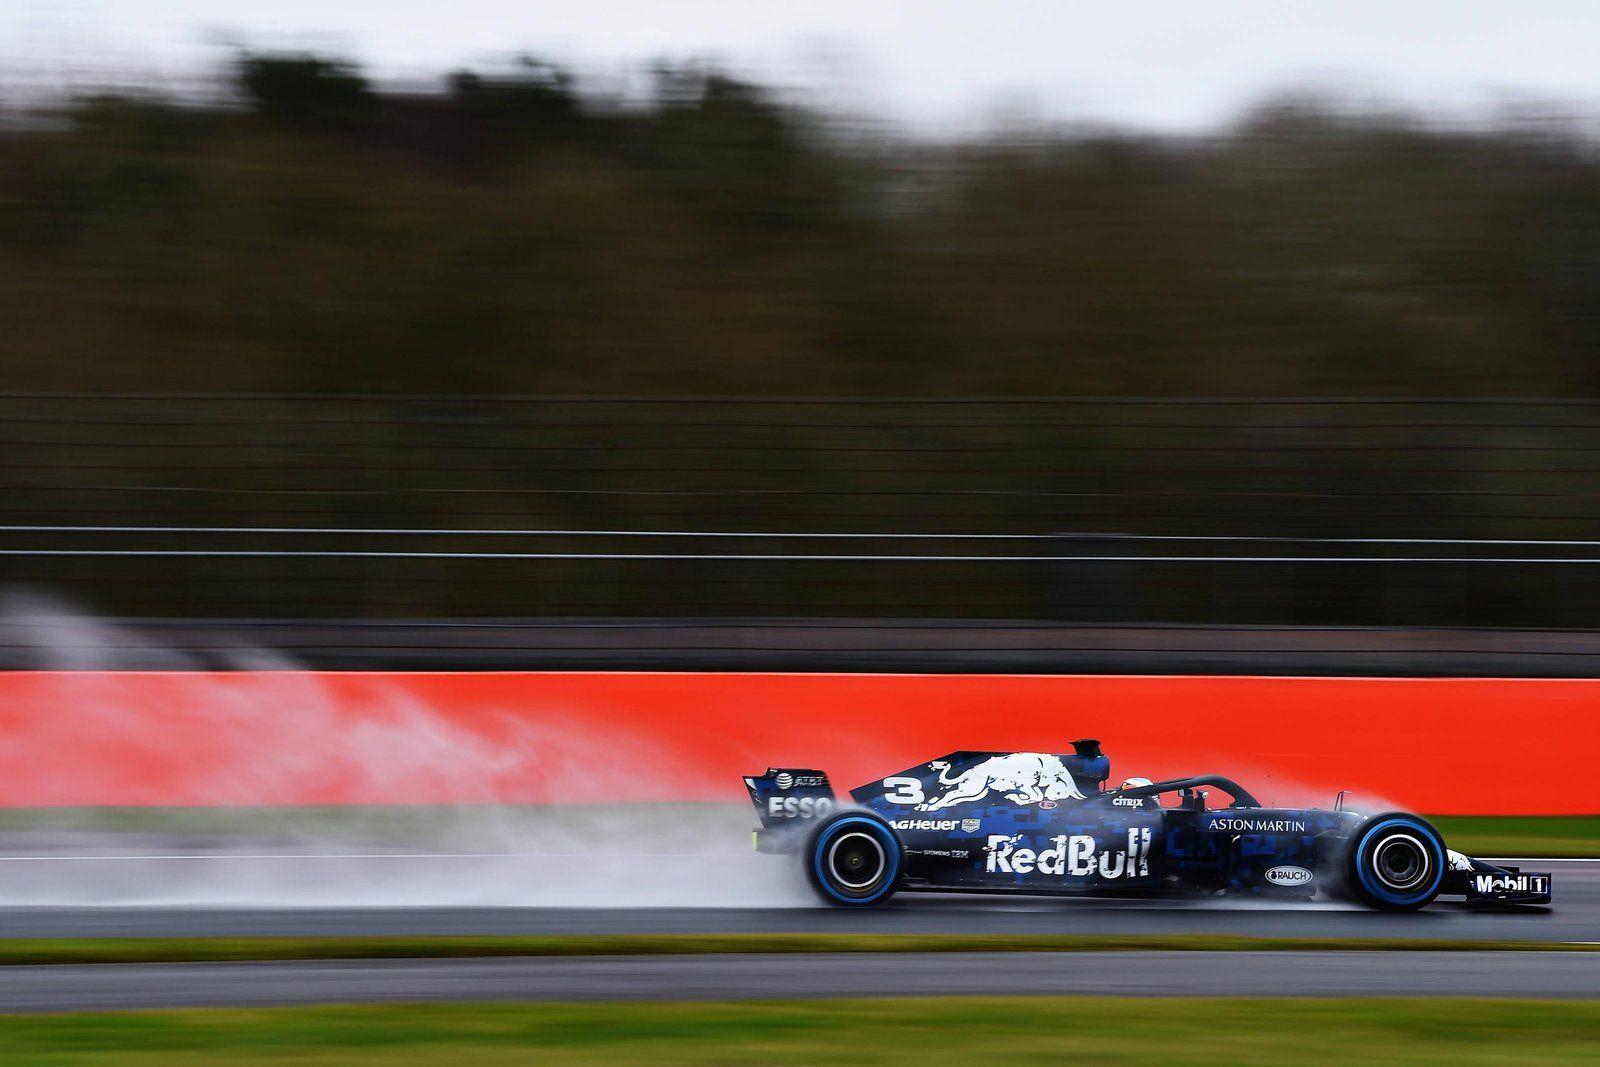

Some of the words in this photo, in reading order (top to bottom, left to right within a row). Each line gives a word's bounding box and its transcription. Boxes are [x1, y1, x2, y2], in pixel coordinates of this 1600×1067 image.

[883, 777, 925, 804] 3
[888, 819, 960, 831] AGHeuer
[1208, 819, 1254, 831] ASTON
[1256, 820, 1305, 832] MARTIN
[1278, 872, 1307, 880] RAUCH
[1476, 875, 1528, 893] Mobil
